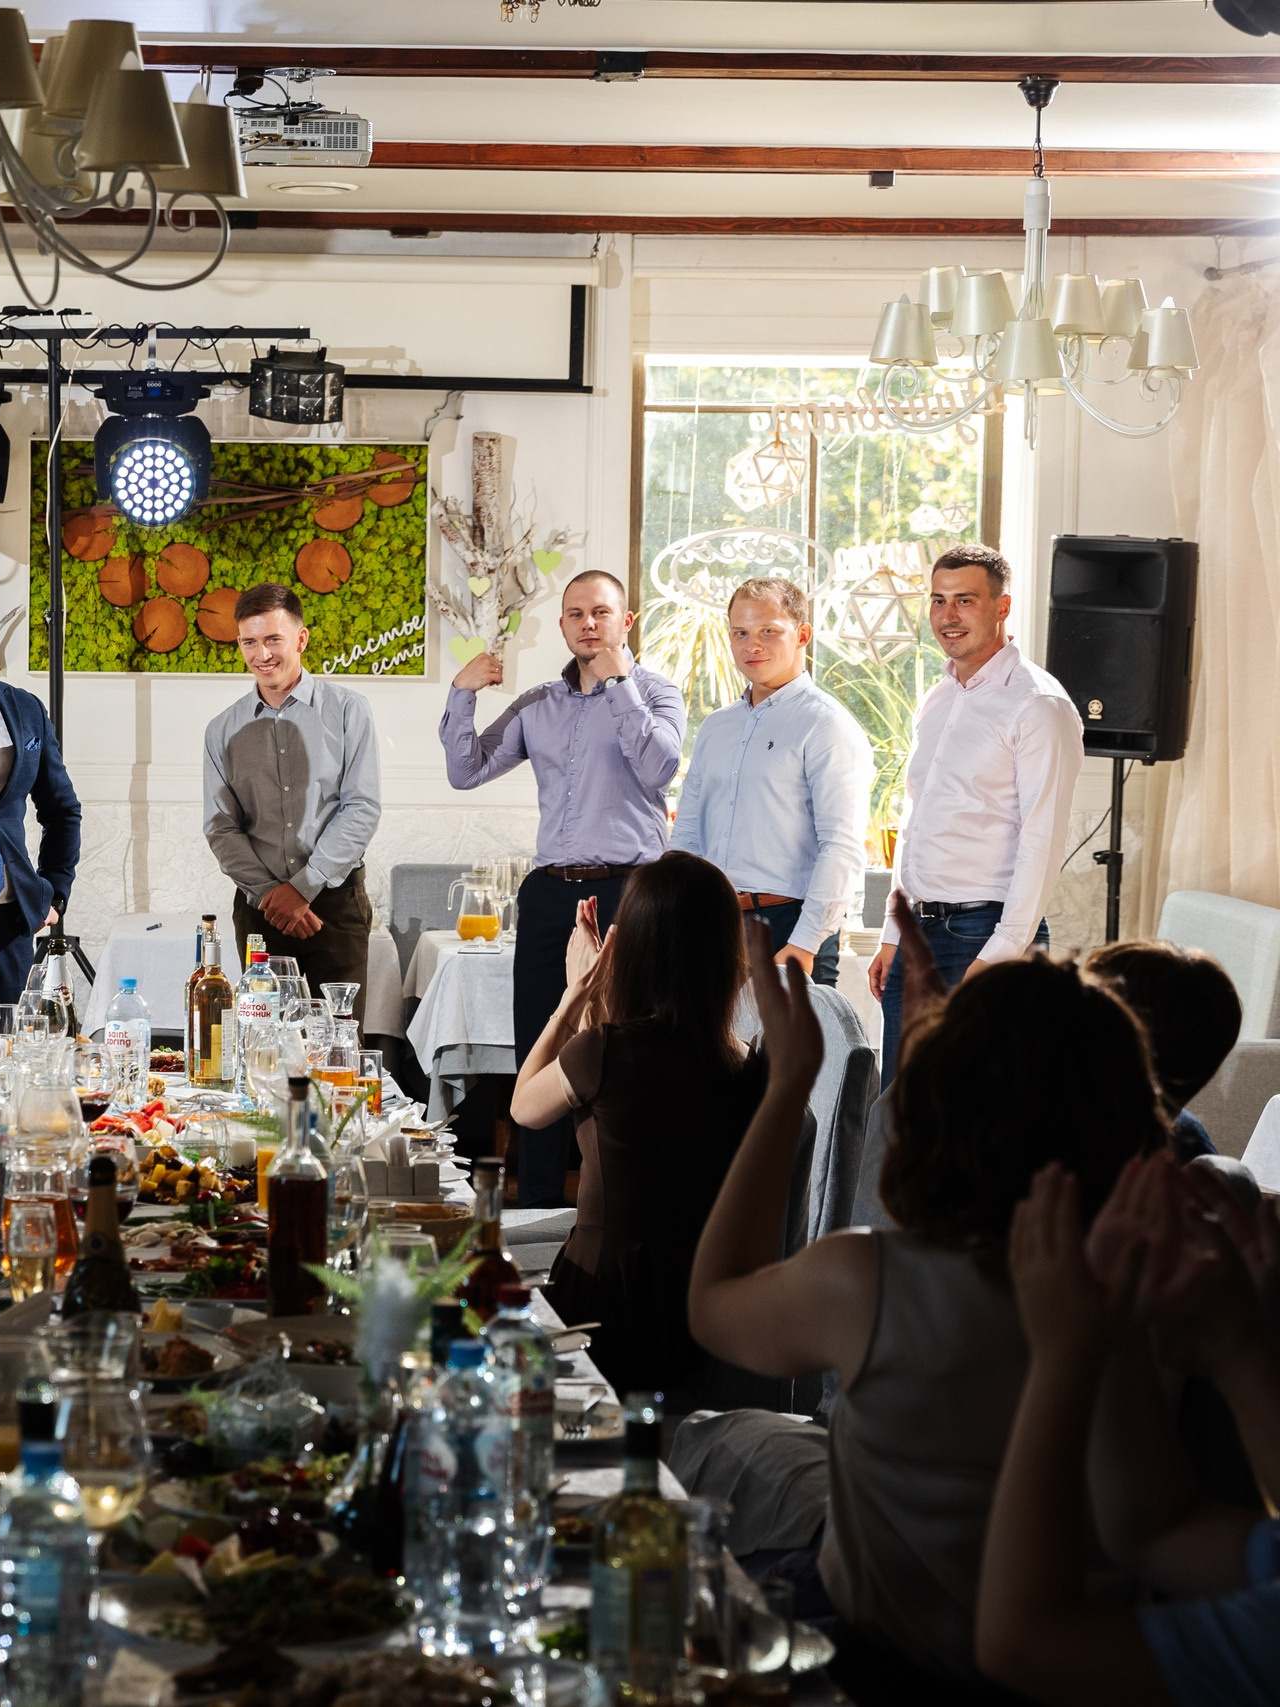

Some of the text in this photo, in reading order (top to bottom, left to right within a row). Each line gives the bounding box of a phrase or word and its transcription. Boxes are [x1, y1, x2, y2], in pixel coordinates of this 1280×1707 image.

[322, 614, 426, 675] счастье
[371, 642, 425, 676] есть
[106, 1038, 132, 1048] spring
[108, 1030, 128, 1038] saint
